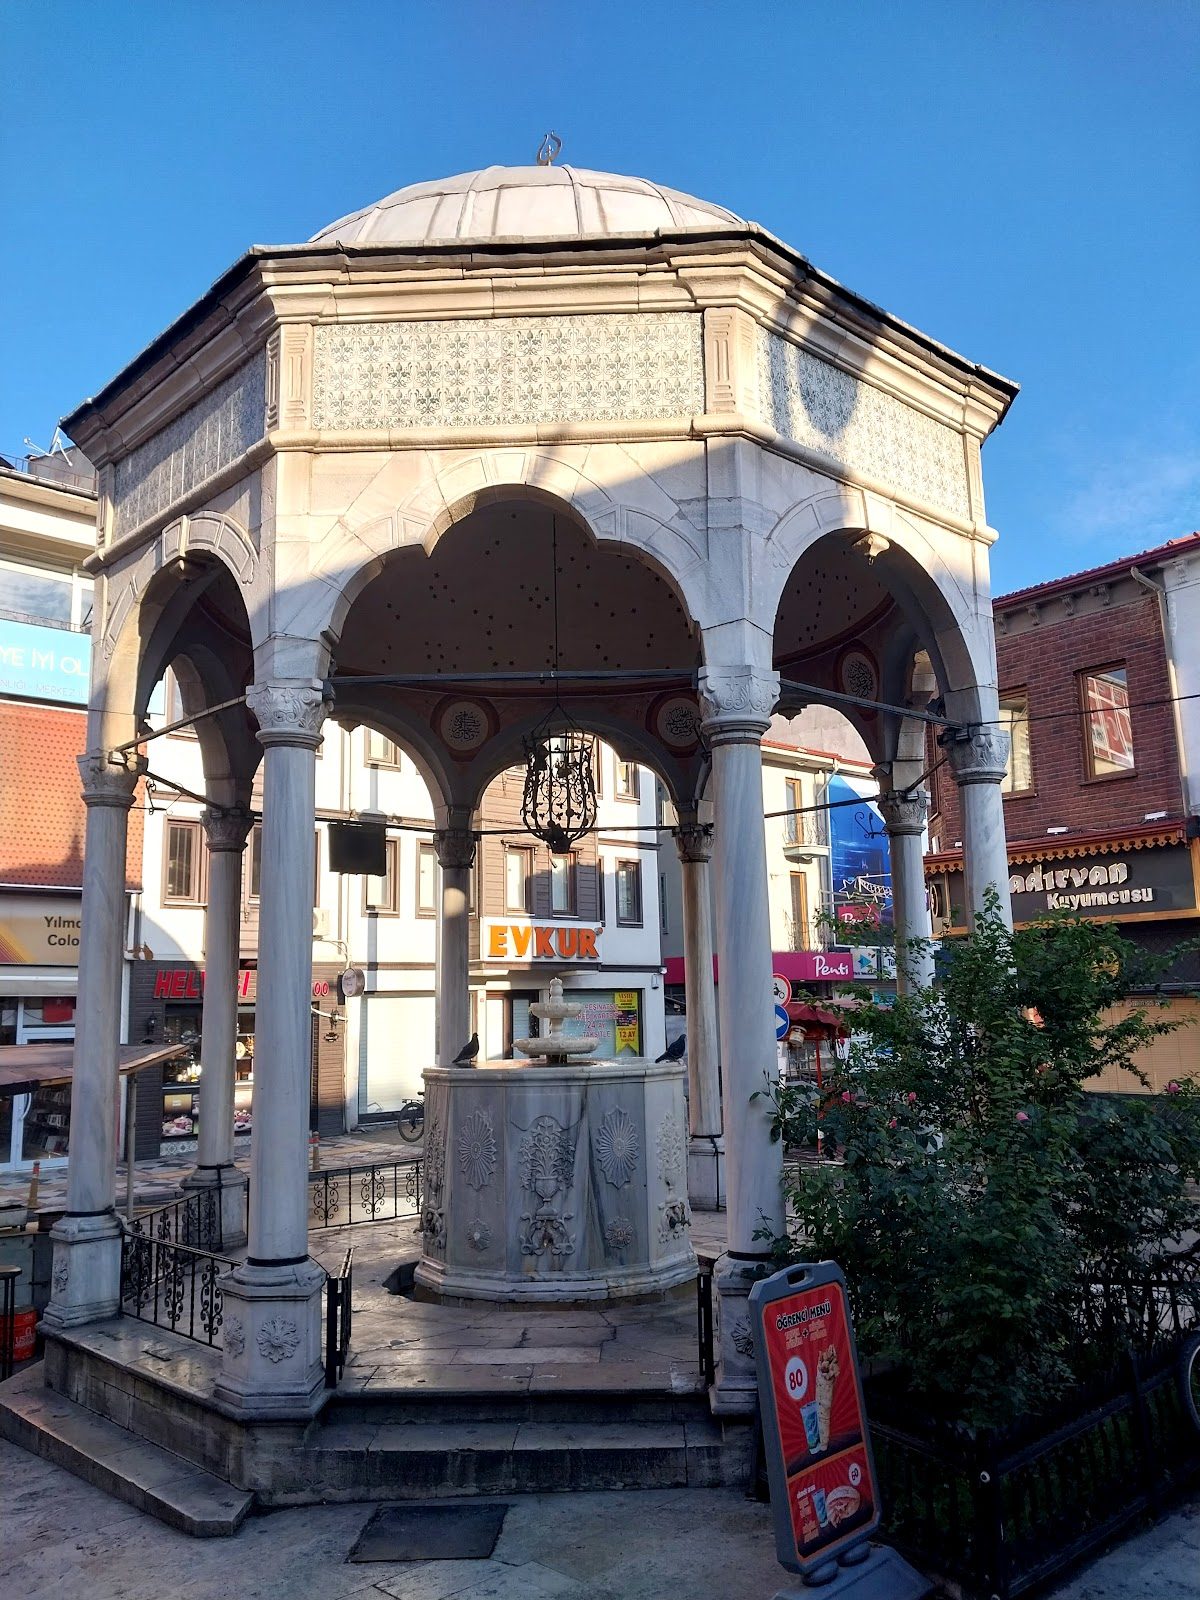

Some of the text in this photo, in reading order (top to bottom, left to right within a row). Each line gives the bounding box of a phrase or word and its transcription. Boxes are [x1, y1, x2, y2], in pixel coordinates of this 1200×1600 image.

[1047, 887, 1154, 912] Kuyumcusu
[488, 925, 600, 958] EVKUR
[812, 955, 849, 978] Penti
[776, 1304, 809, 1331] ÖĞRENCİ
[809, 1298, 832, 1320] MENÜ
[789, 1368, 803, 1391] 80
